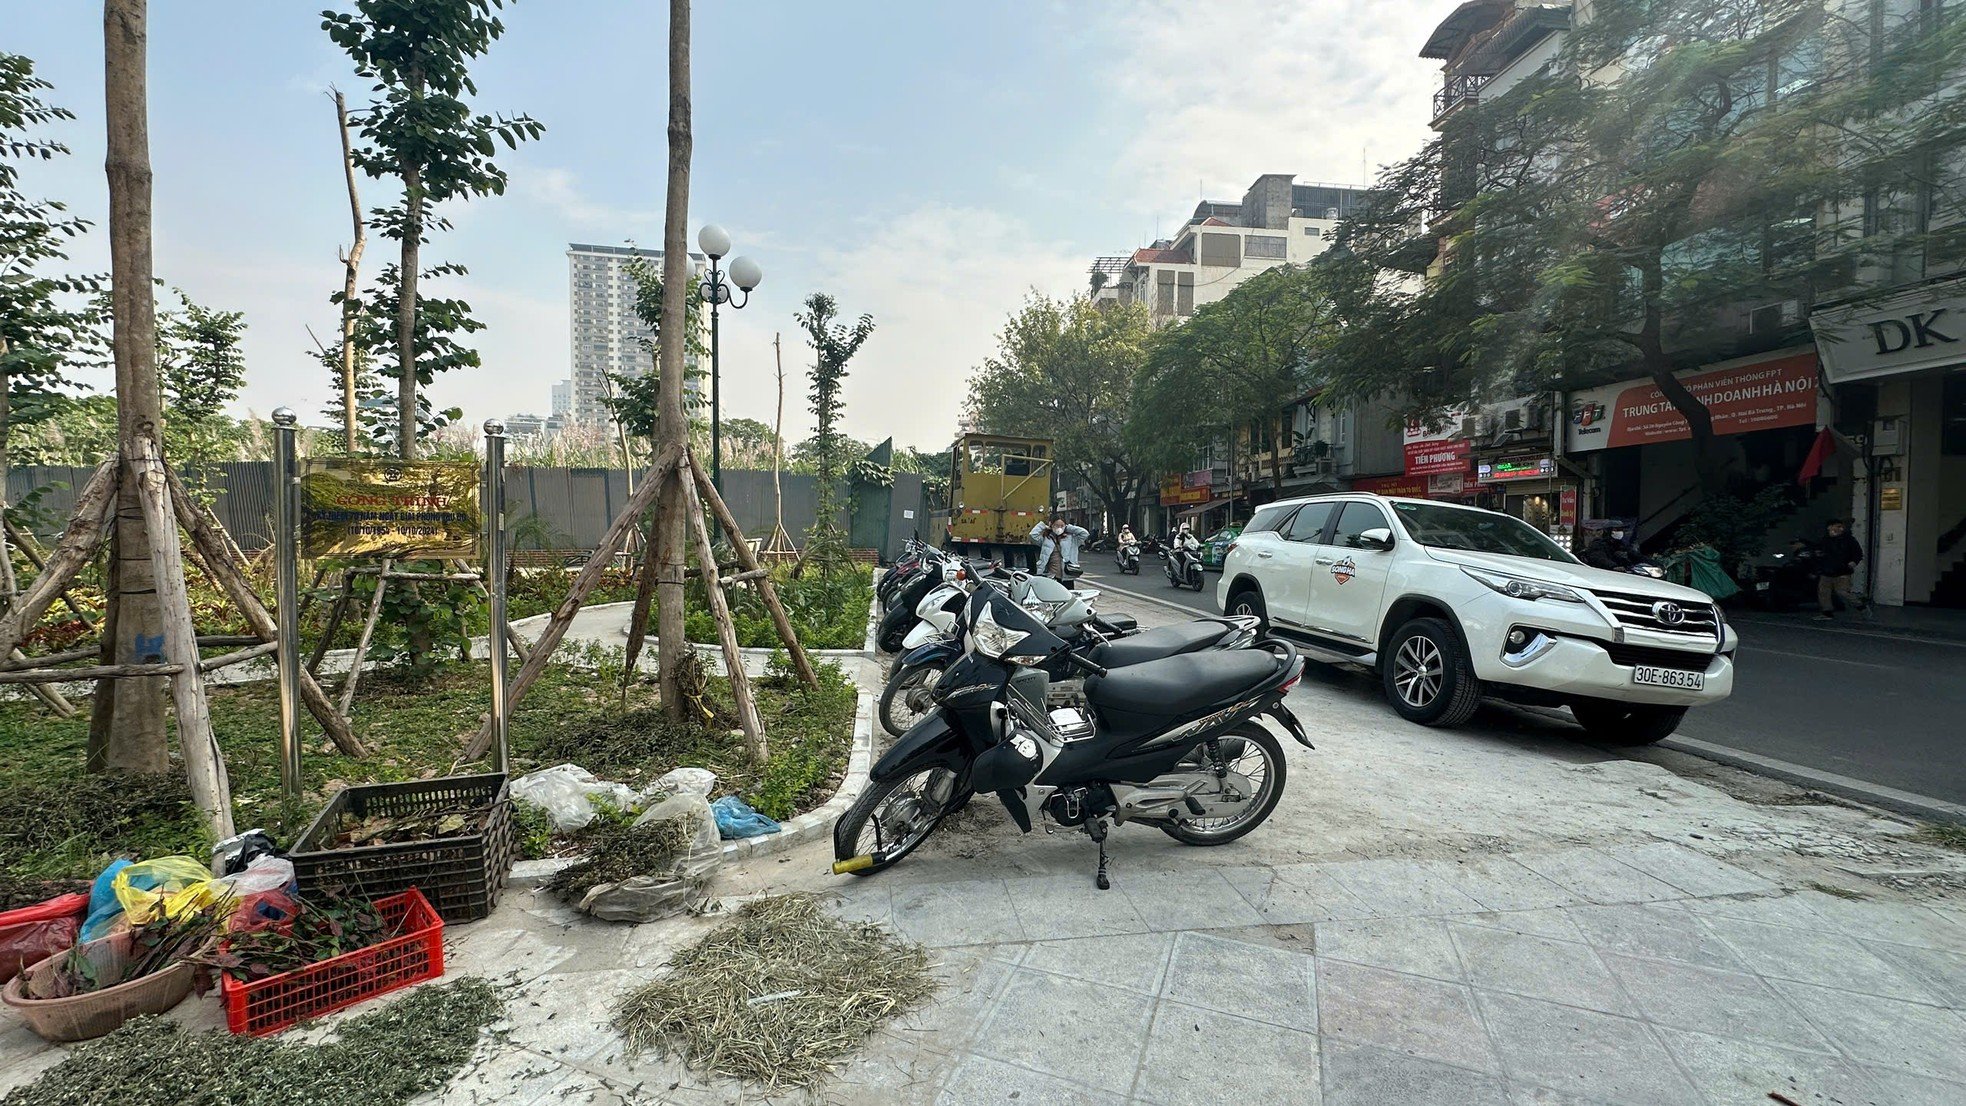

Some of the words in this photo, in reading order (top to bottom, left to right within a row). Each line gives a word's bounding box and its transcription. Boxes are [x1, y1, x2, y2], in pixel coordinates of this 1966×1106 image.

[1867, 308, 1960, 355] DK
[1735, 372, 1765, 383] THÔNG
[1765, 369, 1782, 379] FPT
[1623, 405, 1658, 418] TRUNG
[1660, 400, 1676, 412] TÂ
[1714, 385, 1761, 404] DOANH
[1763, 380, 1783, 396] HÀ
[1785, 375, 1812, 393] NỘI
[1578, 426, 1602, 436] Telecom
[1415, 453, 1429, 465] TIẾN
[1430, 451, 1456, 463] PHƯƠNG
[1636, 666, 1701, 688] 30E-863.54
